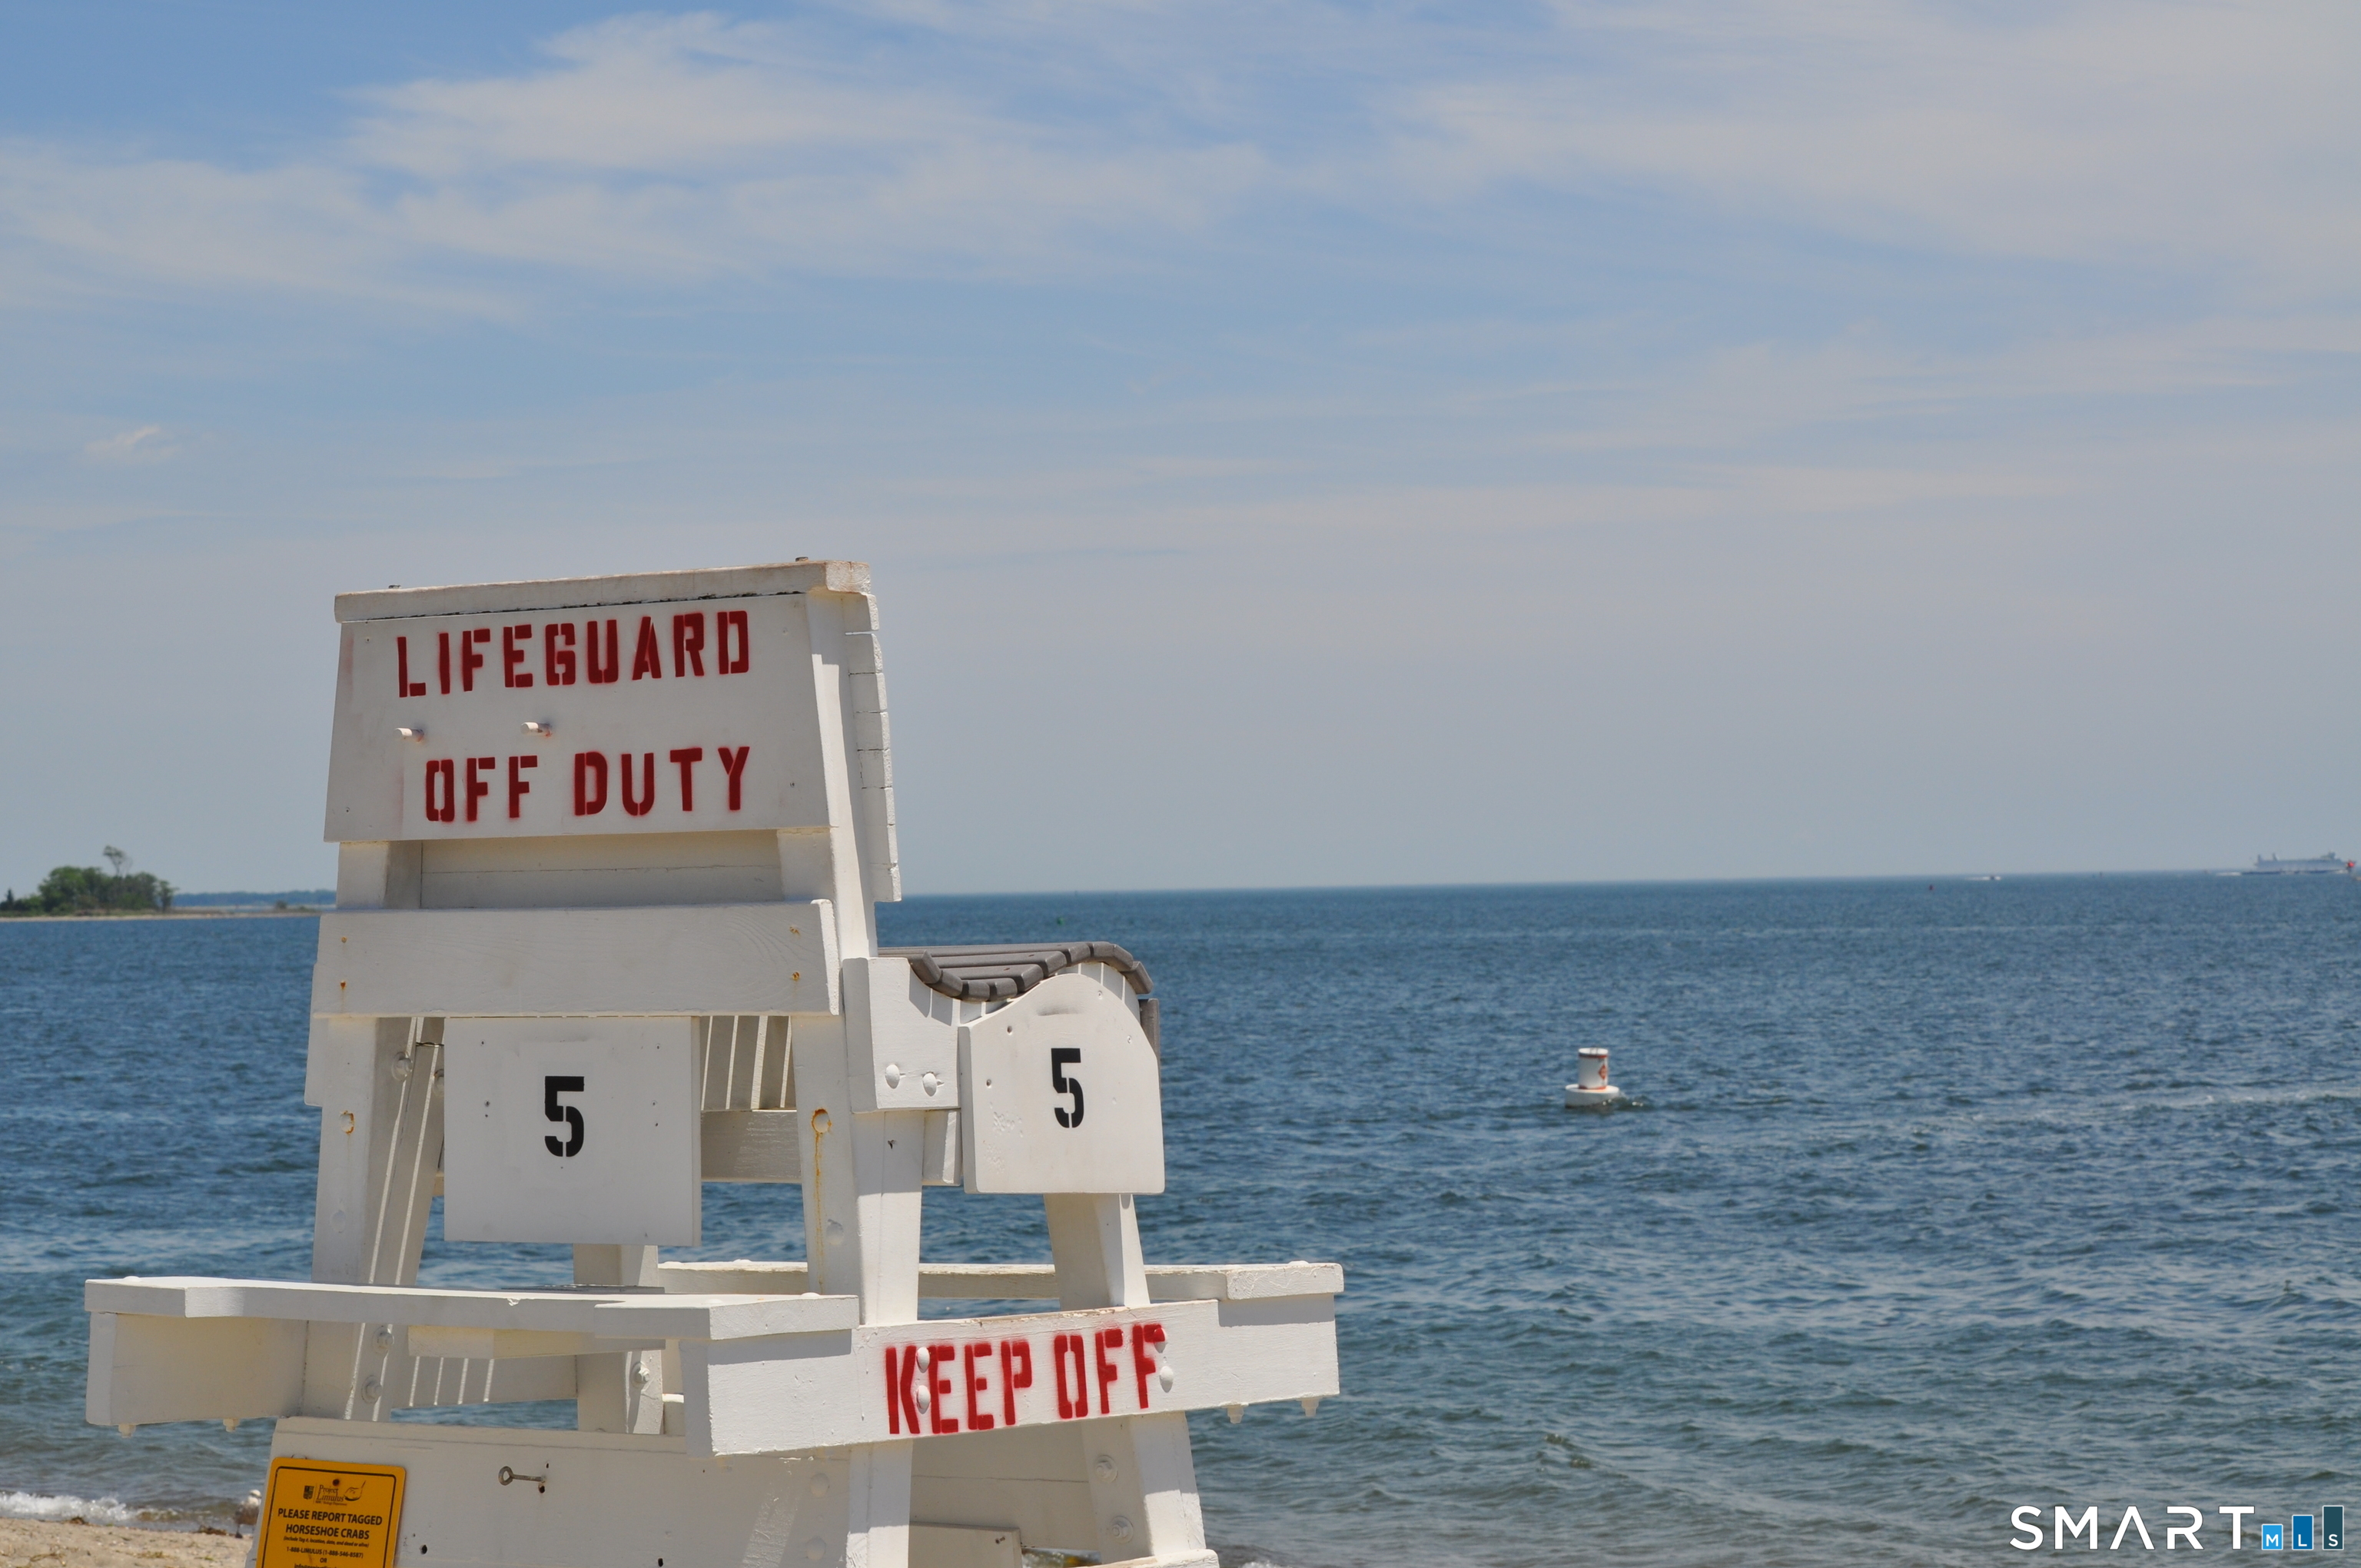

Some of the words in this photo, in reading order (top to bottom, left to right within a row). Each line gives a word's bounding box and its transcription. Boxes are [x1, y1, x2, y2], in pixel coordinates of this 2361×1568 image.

[397, 610, 749, 698] LIFEGUARD
[425, 755, 539, 822] OFF
[574, 746, 750, 816] DUTY
[544, 1075, 585, 1158] 5
[1051, 1048, 1085, 1128] 5
[885, 1340, 1033, 1435] KEEP
[1053, 1323, 1166, 1420] OFF
[277, 1508, 309, 1520] PLEASE
[311, 1510, 346, 1523] REPORT
[347, 1513, 383, 1526] TAGGED
[317, 1492, 344, 1502] Limulus
[318, 1484, 339, 1494] Project
[285, 1523, 339, 1537] HORSESHOE
[340, 1528, 370, 1540] CRABS
